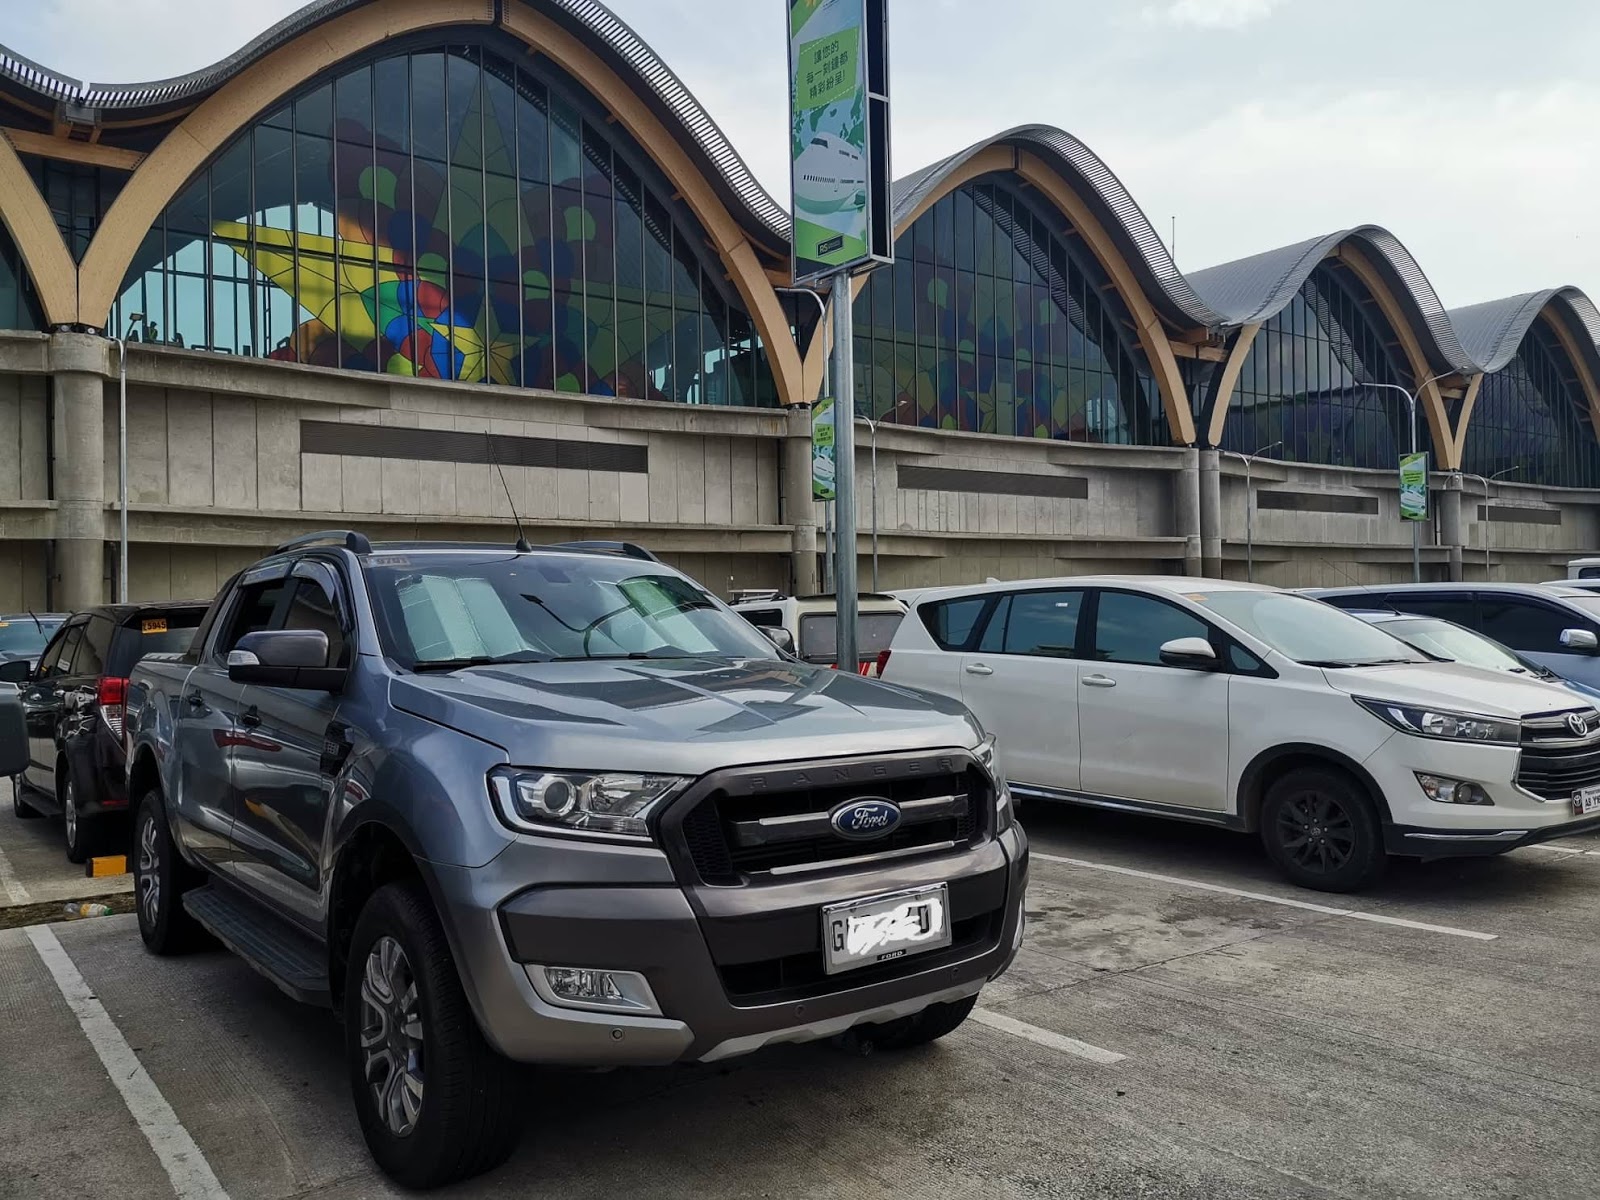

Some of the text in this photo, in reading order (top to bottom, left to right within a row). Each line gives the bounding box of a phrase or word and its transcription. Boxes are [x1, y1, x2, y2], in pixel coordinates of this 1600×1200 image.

[749, 758, 954, 789] RANGER
[850, 806, 888, 829] Ford
[881, 951, 904, 960] FORD
